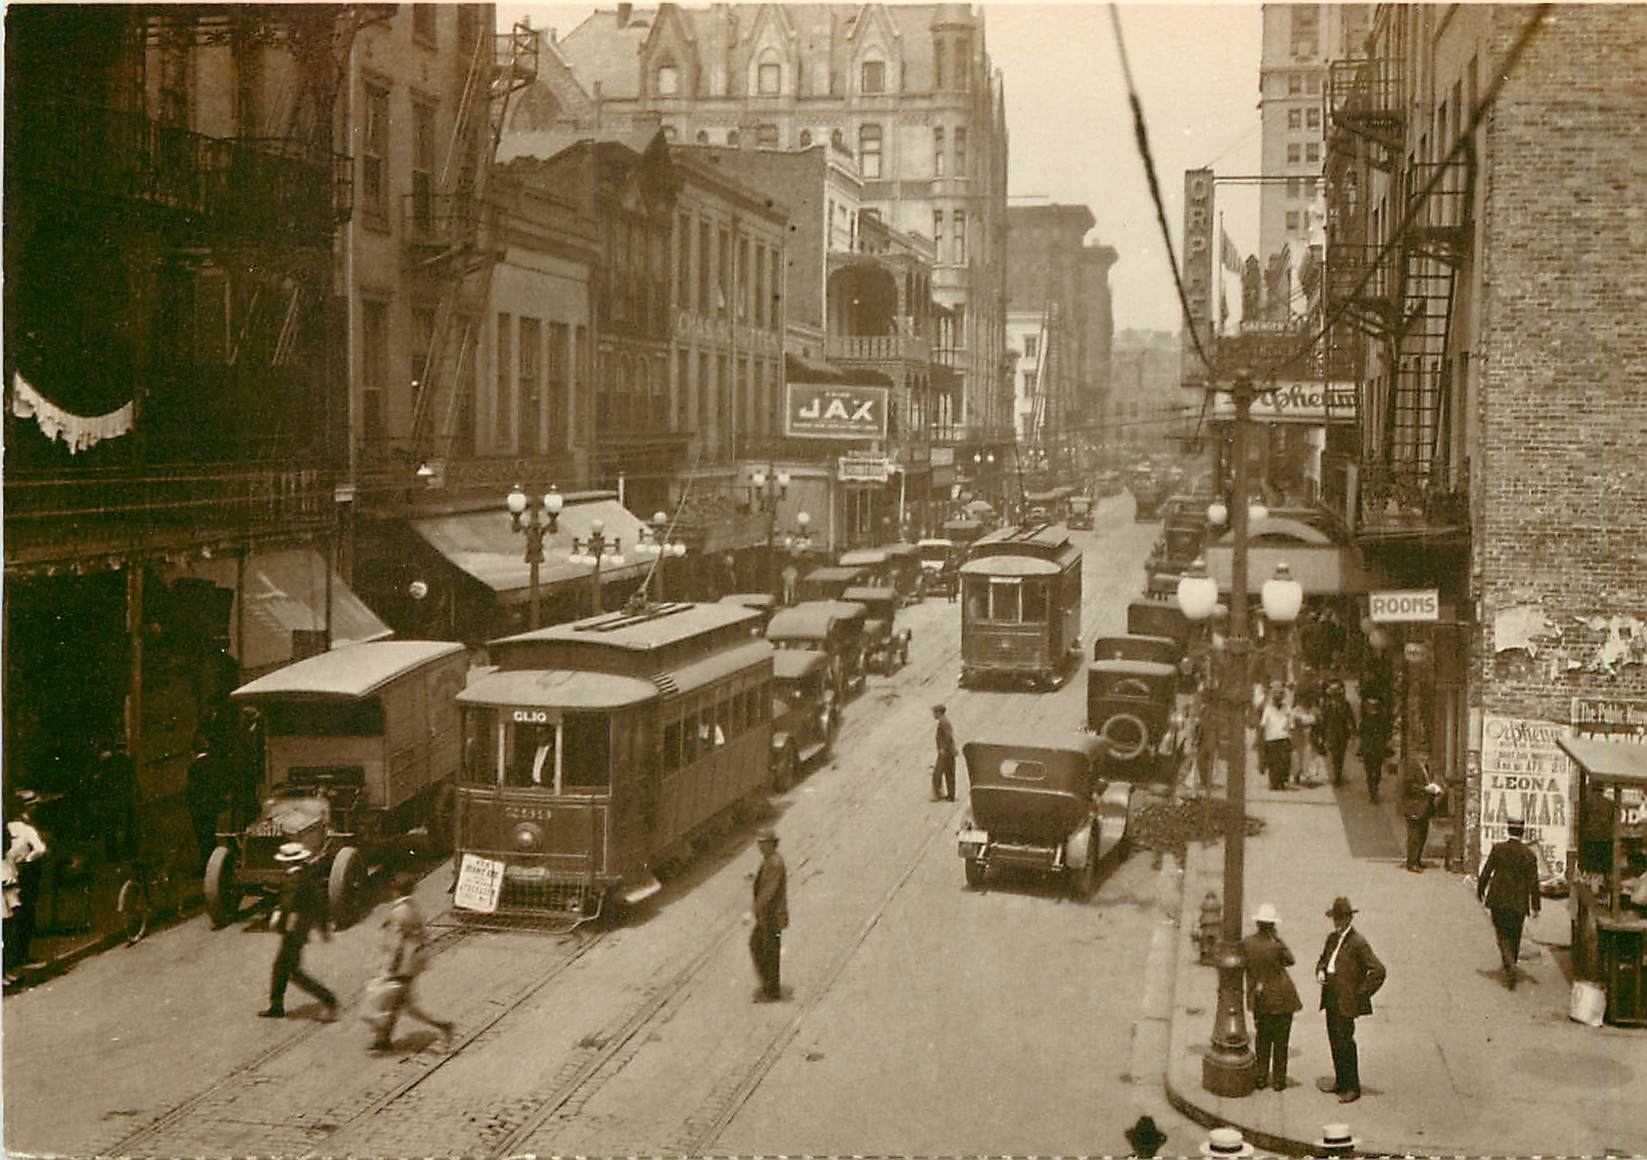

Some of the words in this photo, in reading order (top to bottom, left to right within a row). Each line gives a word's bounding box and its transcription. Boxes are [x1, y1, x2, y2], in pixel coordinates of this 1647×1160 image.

[799, 397, 874, 421] JAX
[1373, 597, 1436, 614] ROOMS
[513, 711, 547, 722] CLIO
[1491, 776, 1560, 791] LEONA
[1483, 790, 1508, 824] LA
[1520, 792, 1566, 826] MAR
[1483, 825, 1508, 840] THE
[1523, 826, 1542, 841] IRL
